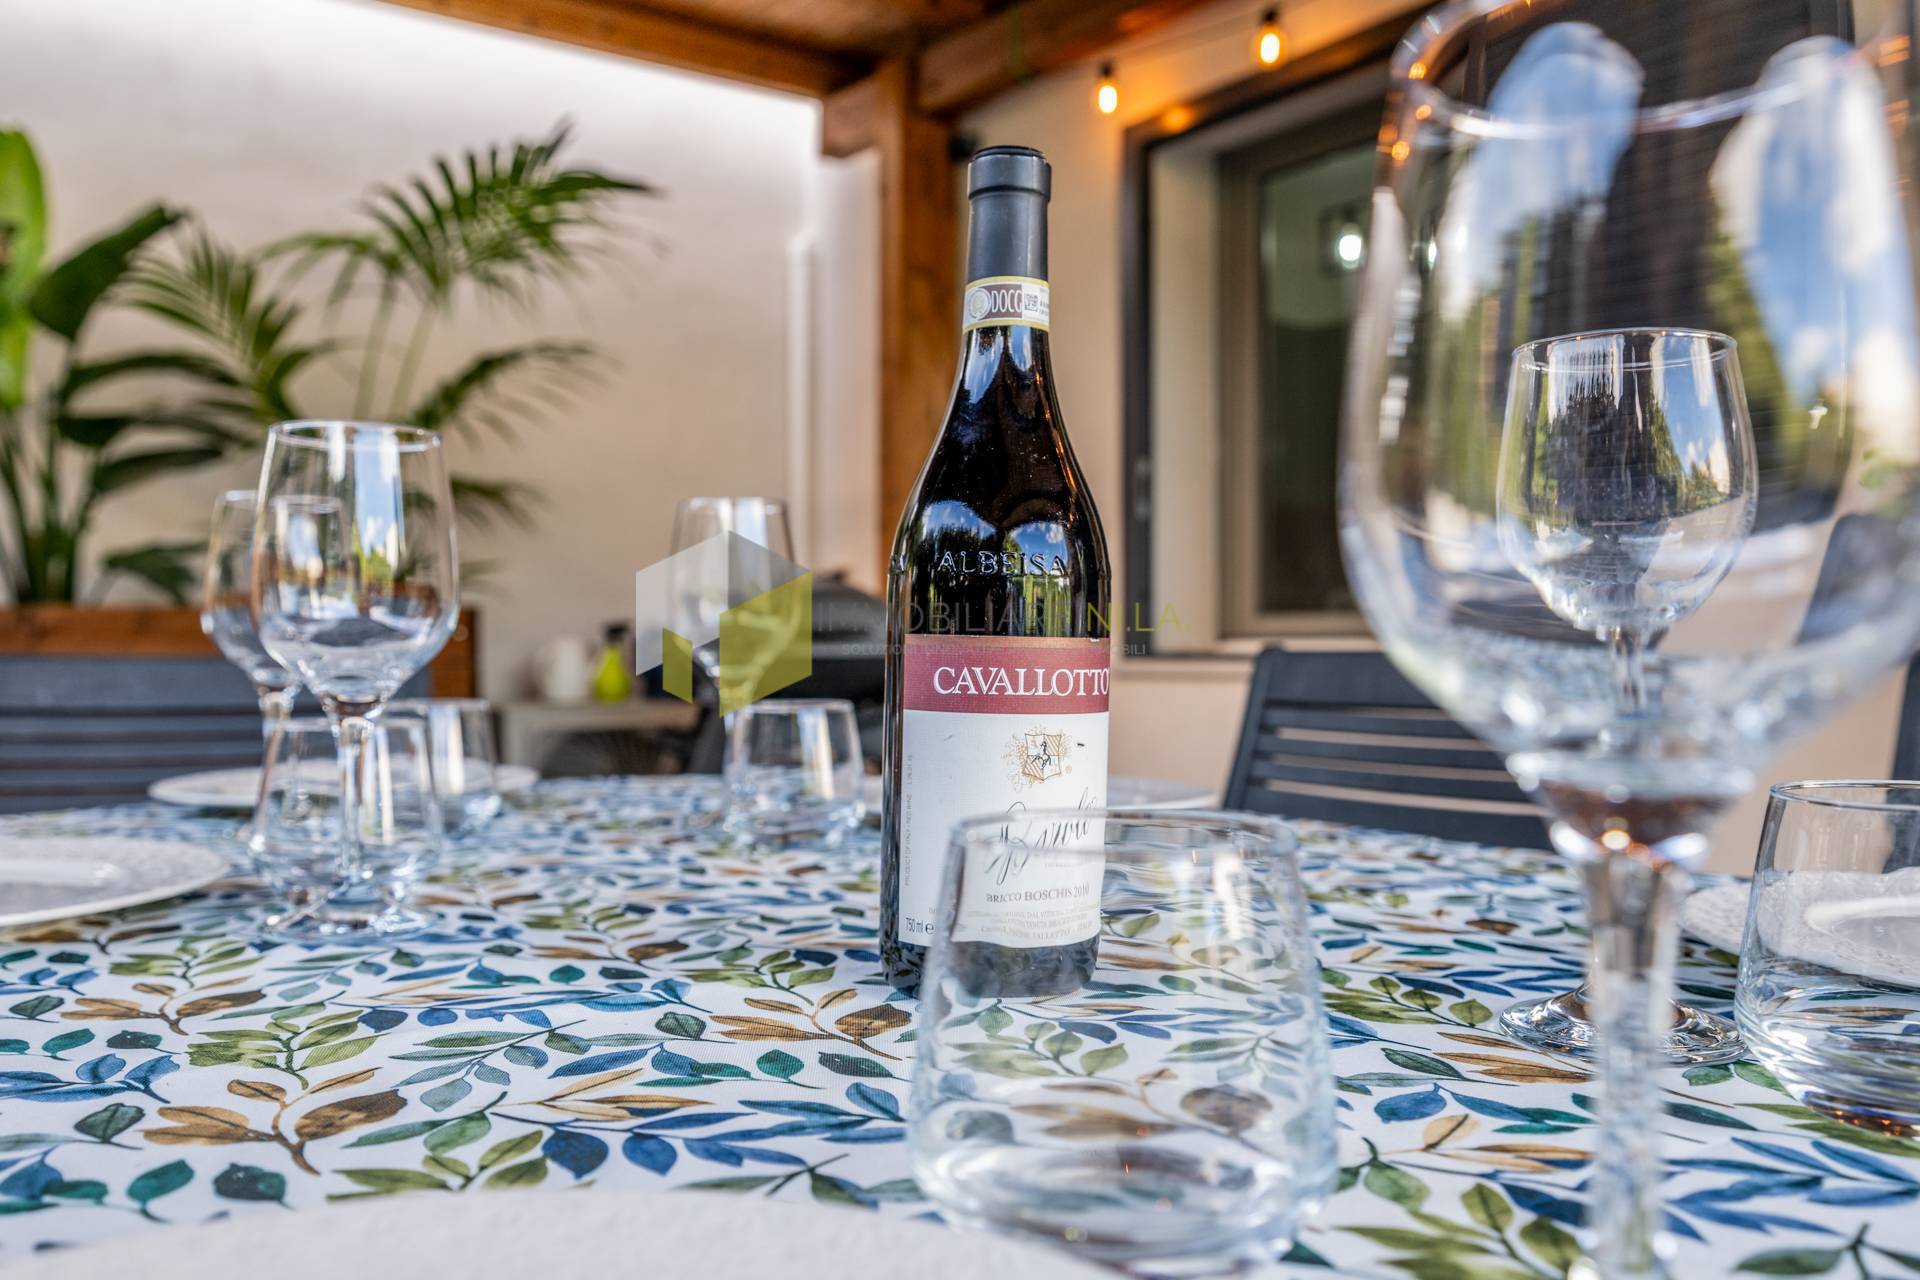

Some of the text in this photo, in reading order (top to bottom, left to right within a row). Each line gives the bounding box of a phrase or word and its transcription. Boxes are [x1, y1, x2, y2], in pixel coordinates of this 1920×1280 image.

[991, 289, 1022, 312] DOCG
[936, 551, 1069, 577] ALBEISA
[933, 666, 1109, 697] CAVALLOTTO
[986, 891, 1022, 903] BRICCO
[1024, 887, 1073, 901] BOSCHIS
